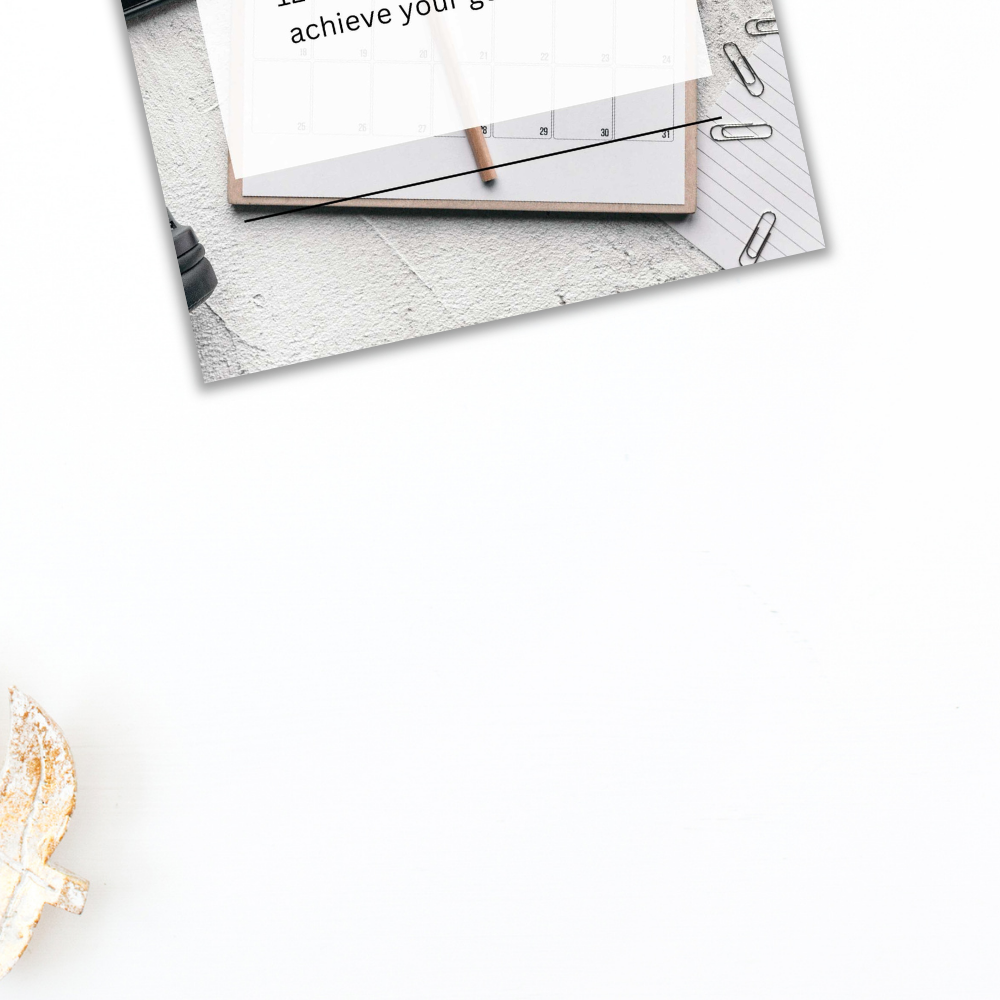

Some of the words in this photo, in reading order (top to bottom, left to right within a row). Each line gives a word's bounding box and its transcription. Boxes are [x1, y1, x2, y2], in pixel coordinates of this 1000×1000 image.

[290, 8, 392, 44] achieve
[539, 126, 549, 136] 29
[600, 127, 610, 138] 30
